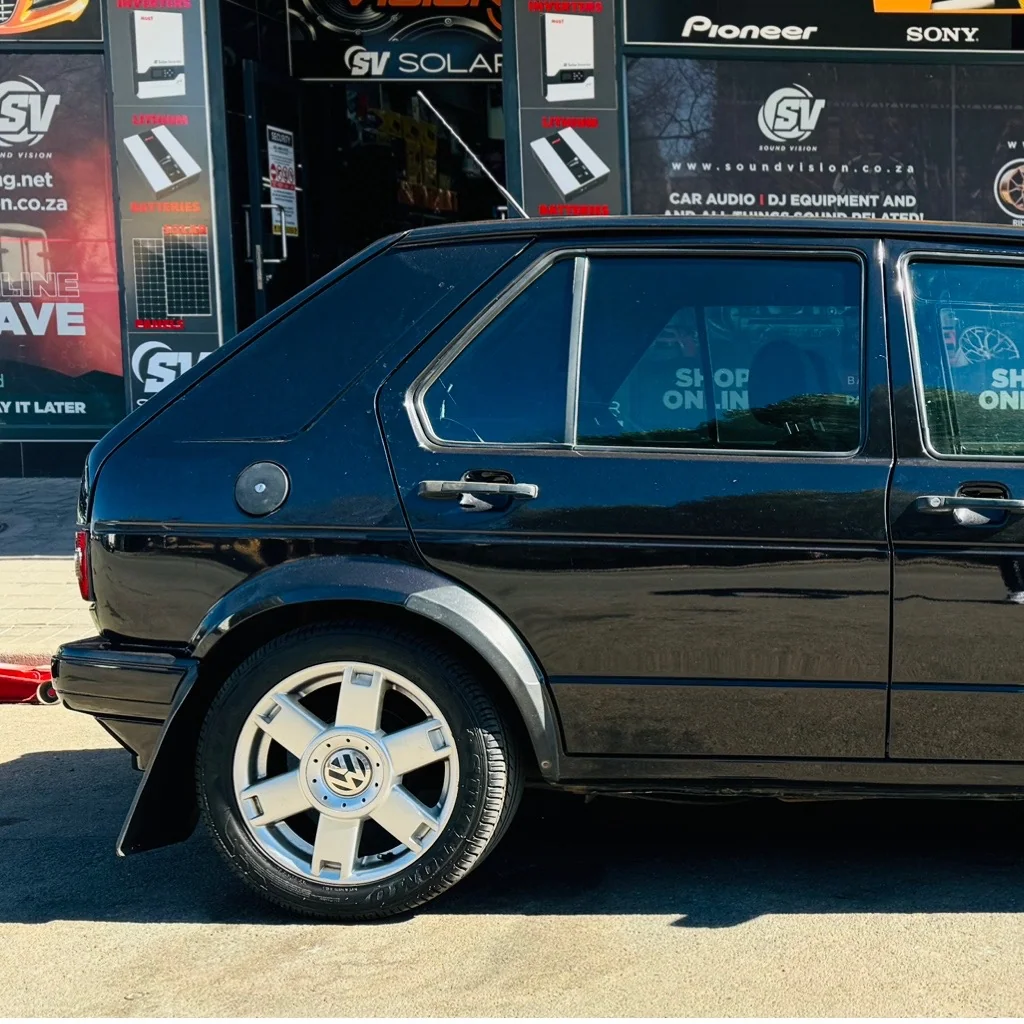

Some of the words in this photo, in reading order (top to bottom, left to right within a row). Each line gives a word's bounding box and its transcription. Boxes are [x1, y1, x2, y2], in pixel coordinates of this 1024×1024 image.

[681, 15, 818, 40] Pioneer
[345, 51, 391, 76] SV
[773, 96, 826, 132] SV
[671, 161, 915, 174] www.soundvision.co.za
[0, 172, 53, 190] g.net
[669, 192, 702, 205] CAR
[706, 193, 755, 205] AUDIO
[768, 194, 786, 206] DJ
[790, 194, 880, 207] EQUIPMENT
[883, 195, 917, 207] AND
[15, 402, 31, 413] IT
[34, 402, 87, 414] LATER
[662, 390, 750, 410] ONIN
